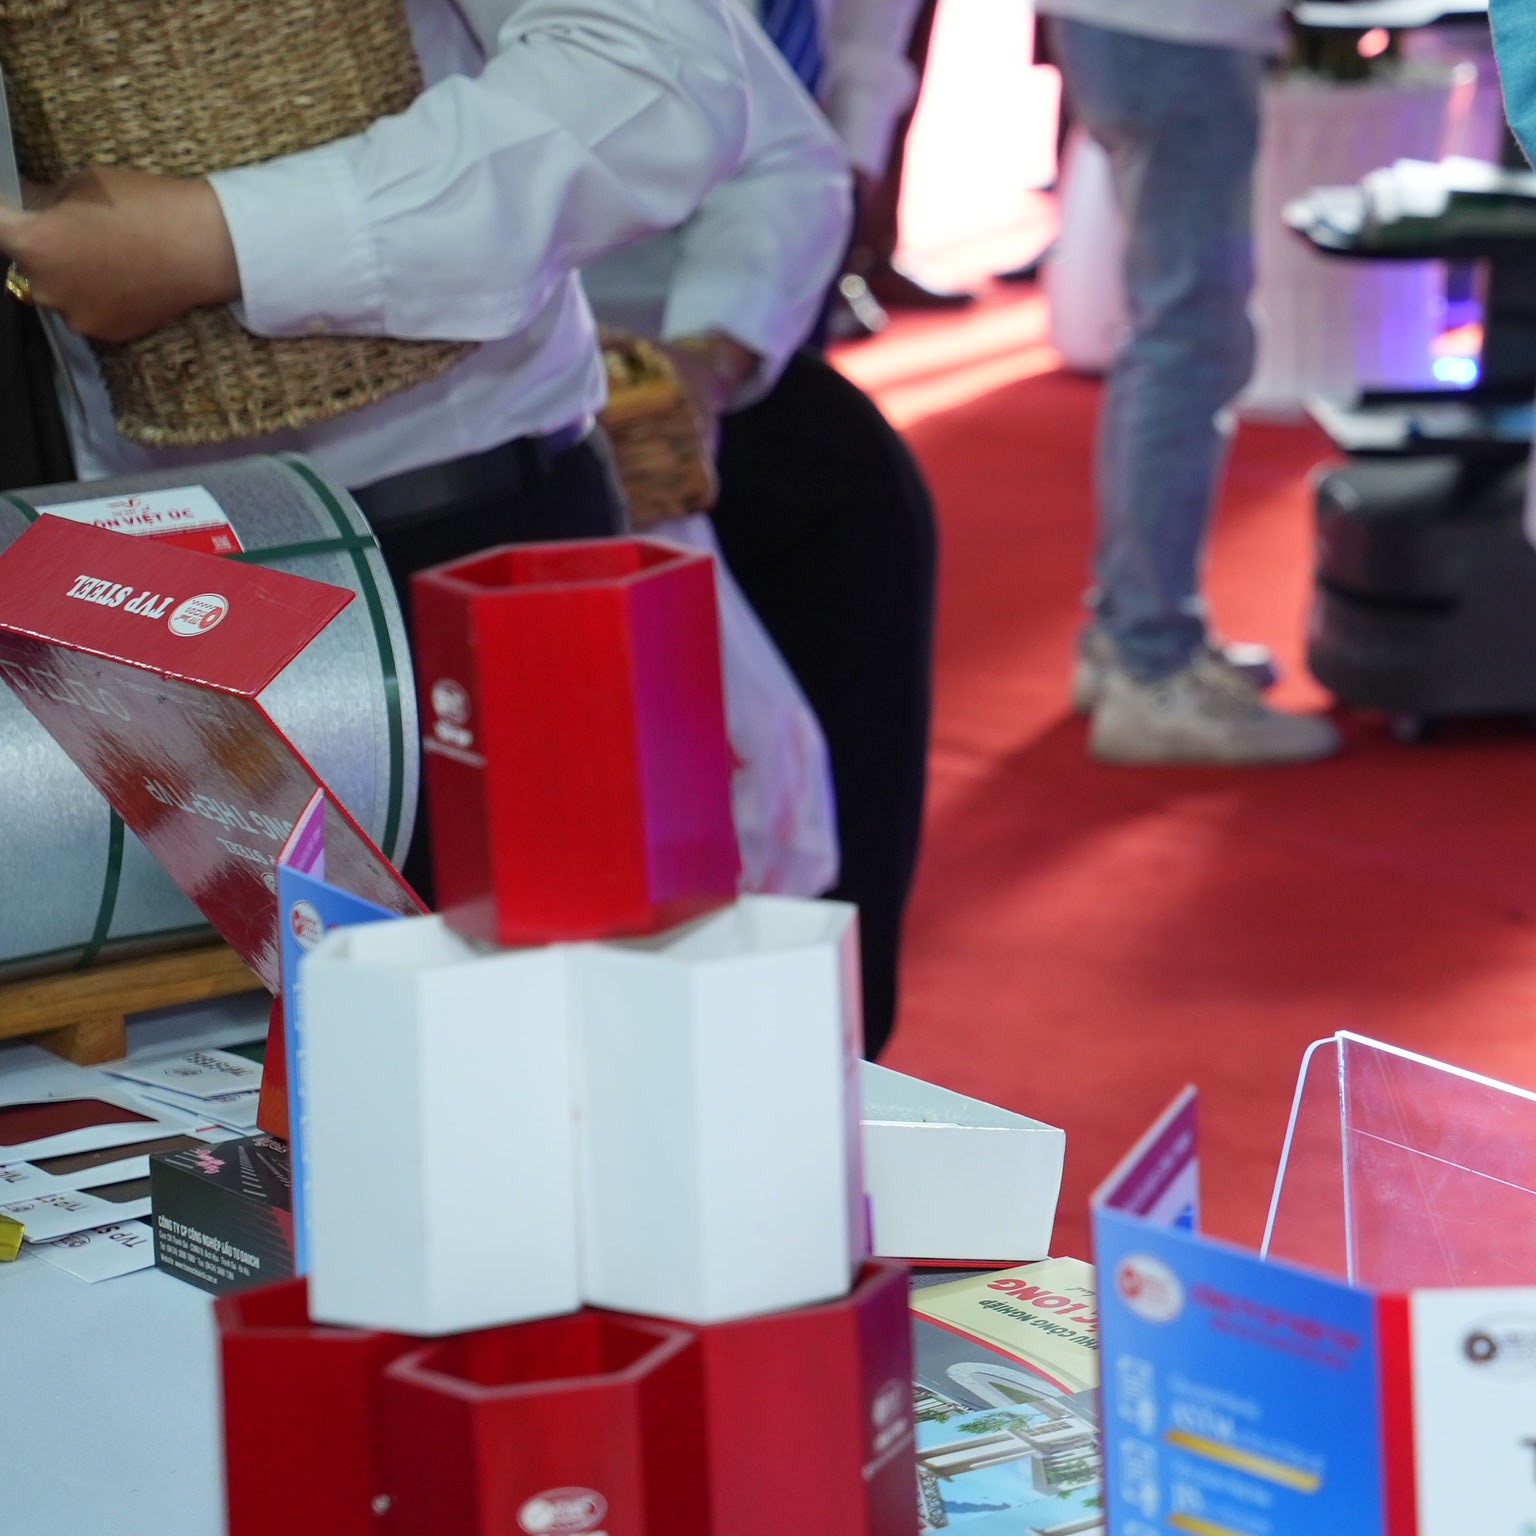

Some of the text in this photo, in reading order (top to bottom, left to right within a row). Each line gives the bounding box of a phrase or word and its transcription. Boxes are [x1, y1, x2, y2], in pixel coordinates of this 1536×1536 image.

[66, 575, 134, 608] STEEL
[124, 591, 175, 619] TVP
[143, 775, 196, 814] TVP
[109, 1231, 147, 1248] TVP
[987, 1278, 1090, 1315] LONG
[979, 1299, 1037, 1323] NGHIỆP
[1030, 1319, 1077, 1340] CÔNG
